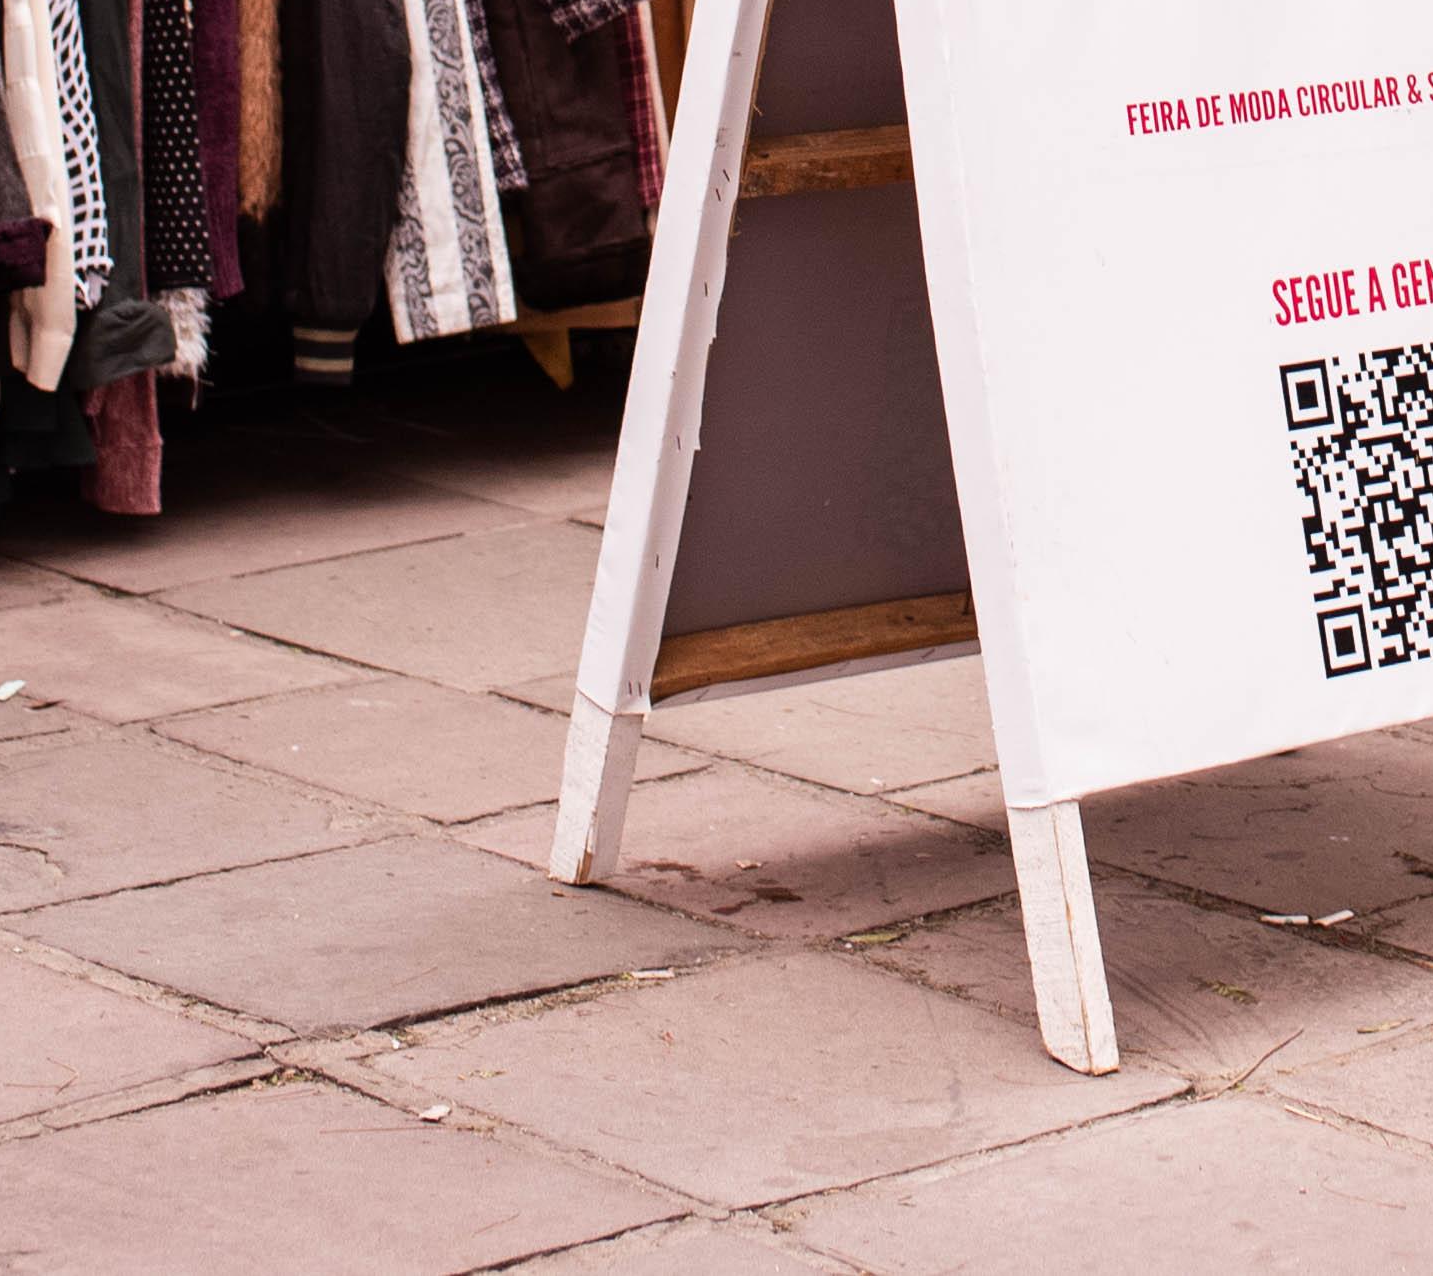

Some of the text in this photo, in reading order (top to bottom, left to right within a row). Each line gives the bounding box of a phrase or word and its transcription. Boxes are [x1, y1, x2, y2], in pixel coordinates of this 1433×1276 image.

[1125, 98, 1192, 136] FEIRA
[1195, 94, 1224, 129] DE
[1228, 87, 1293, 124] MODA
[1295, 76, 1401, 118] CIRCULAR
[1405, 73, 1423, 105] &
[1271, 268, 1361, 327] SEGUE
[1367, 265, 1388, 313] A
